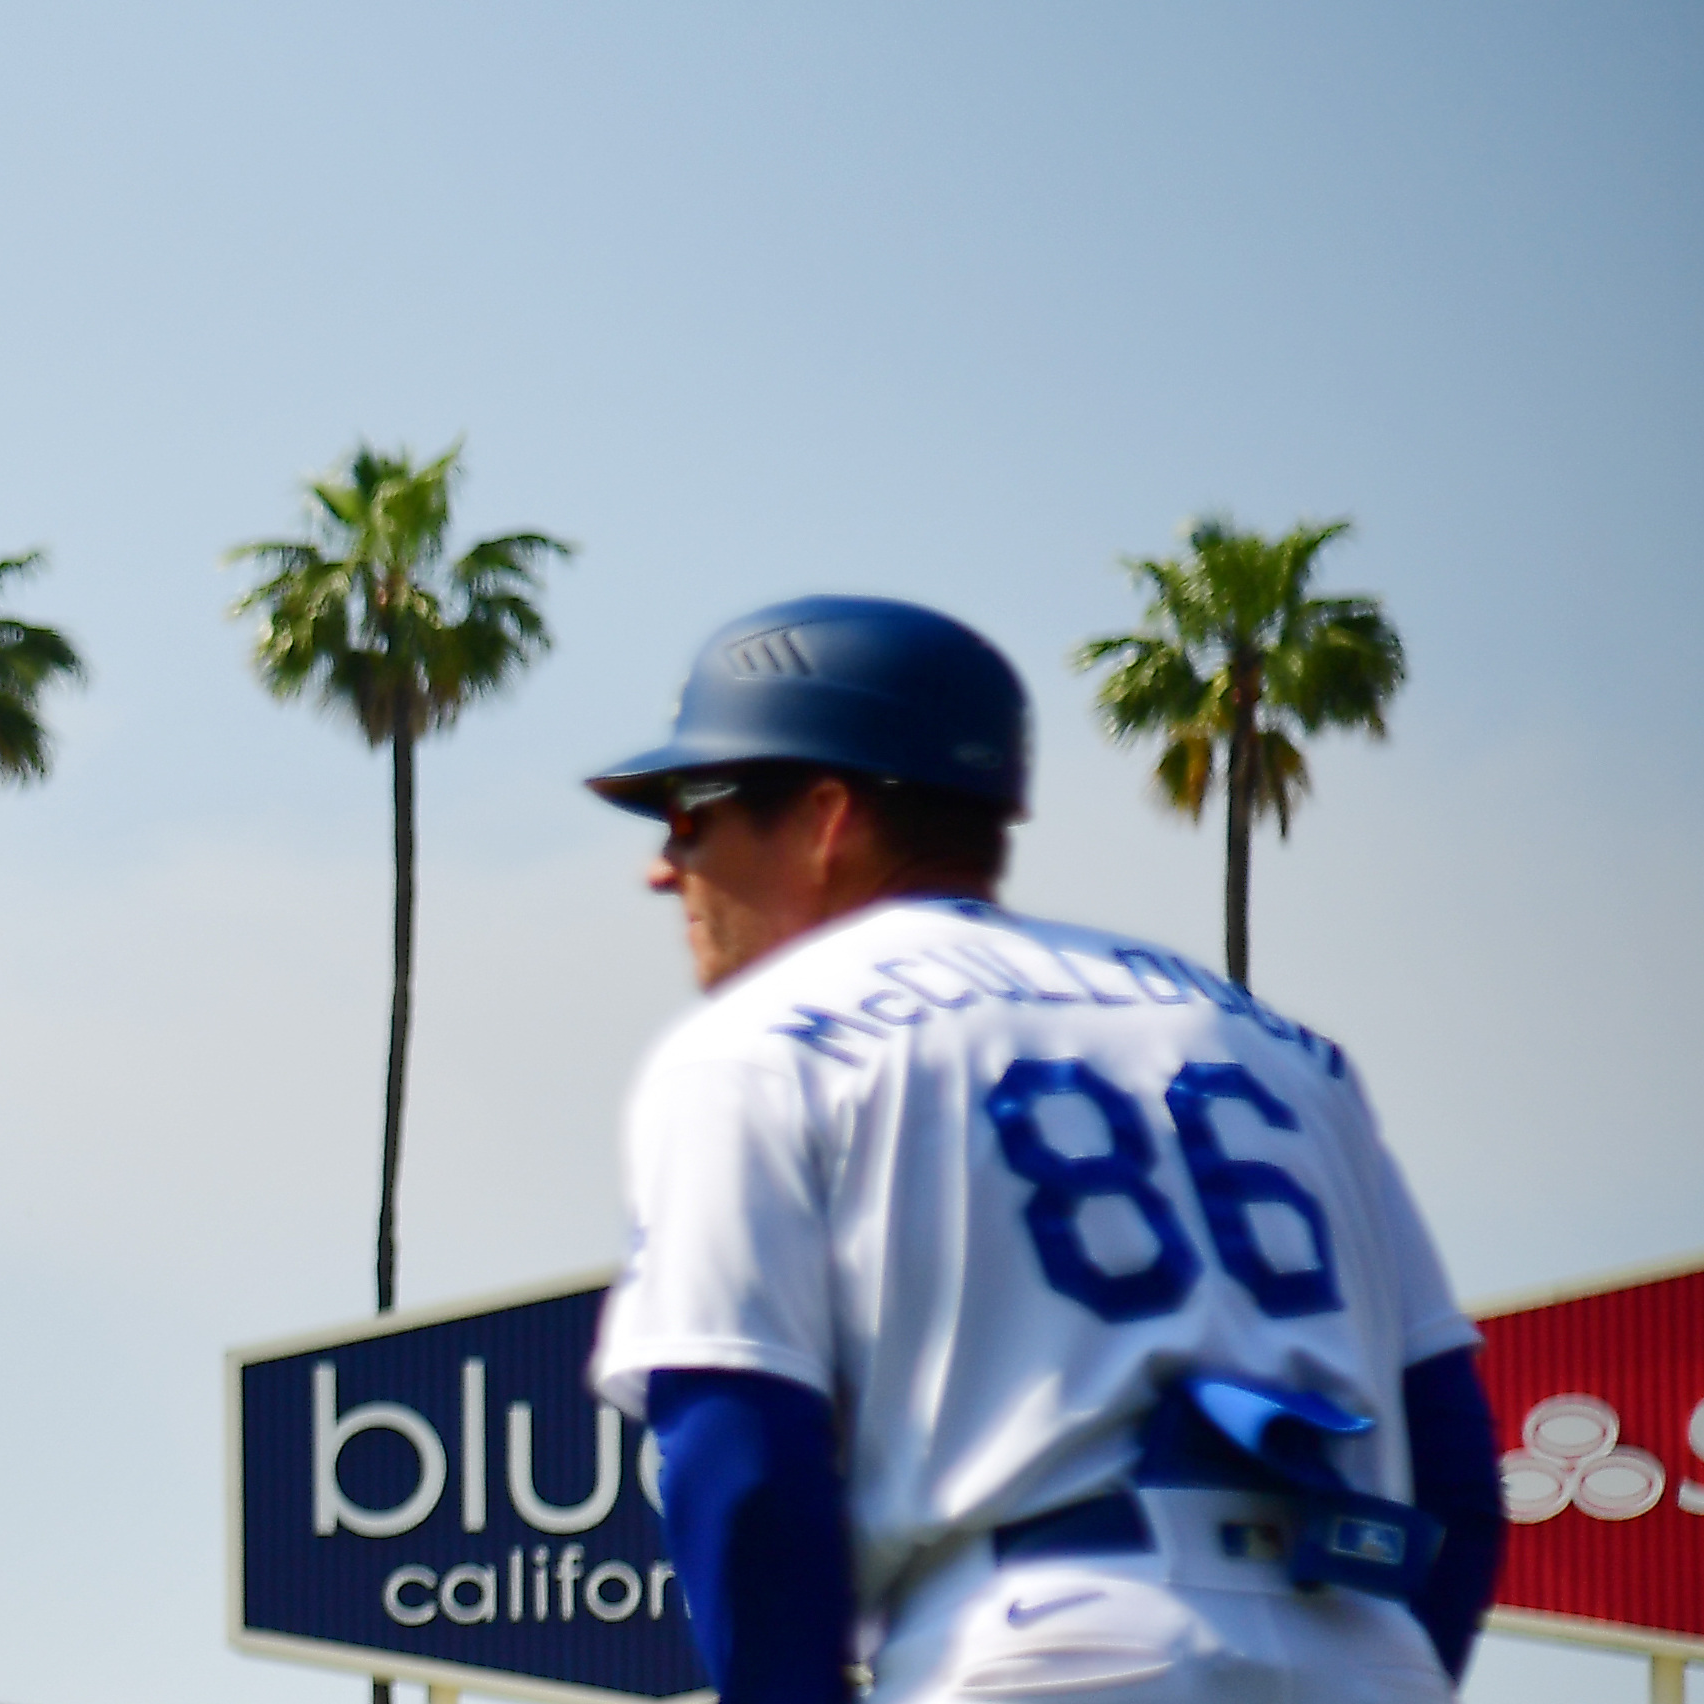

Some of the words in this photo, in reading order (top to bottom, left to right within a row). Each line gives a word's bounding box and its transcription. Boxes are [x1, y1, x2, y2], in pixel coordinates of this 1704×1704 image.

[985, 1056, 1345, 1324] 86
[312, 1355, 665, 1539] blu
[383, 1542, 691, 1627] califor
